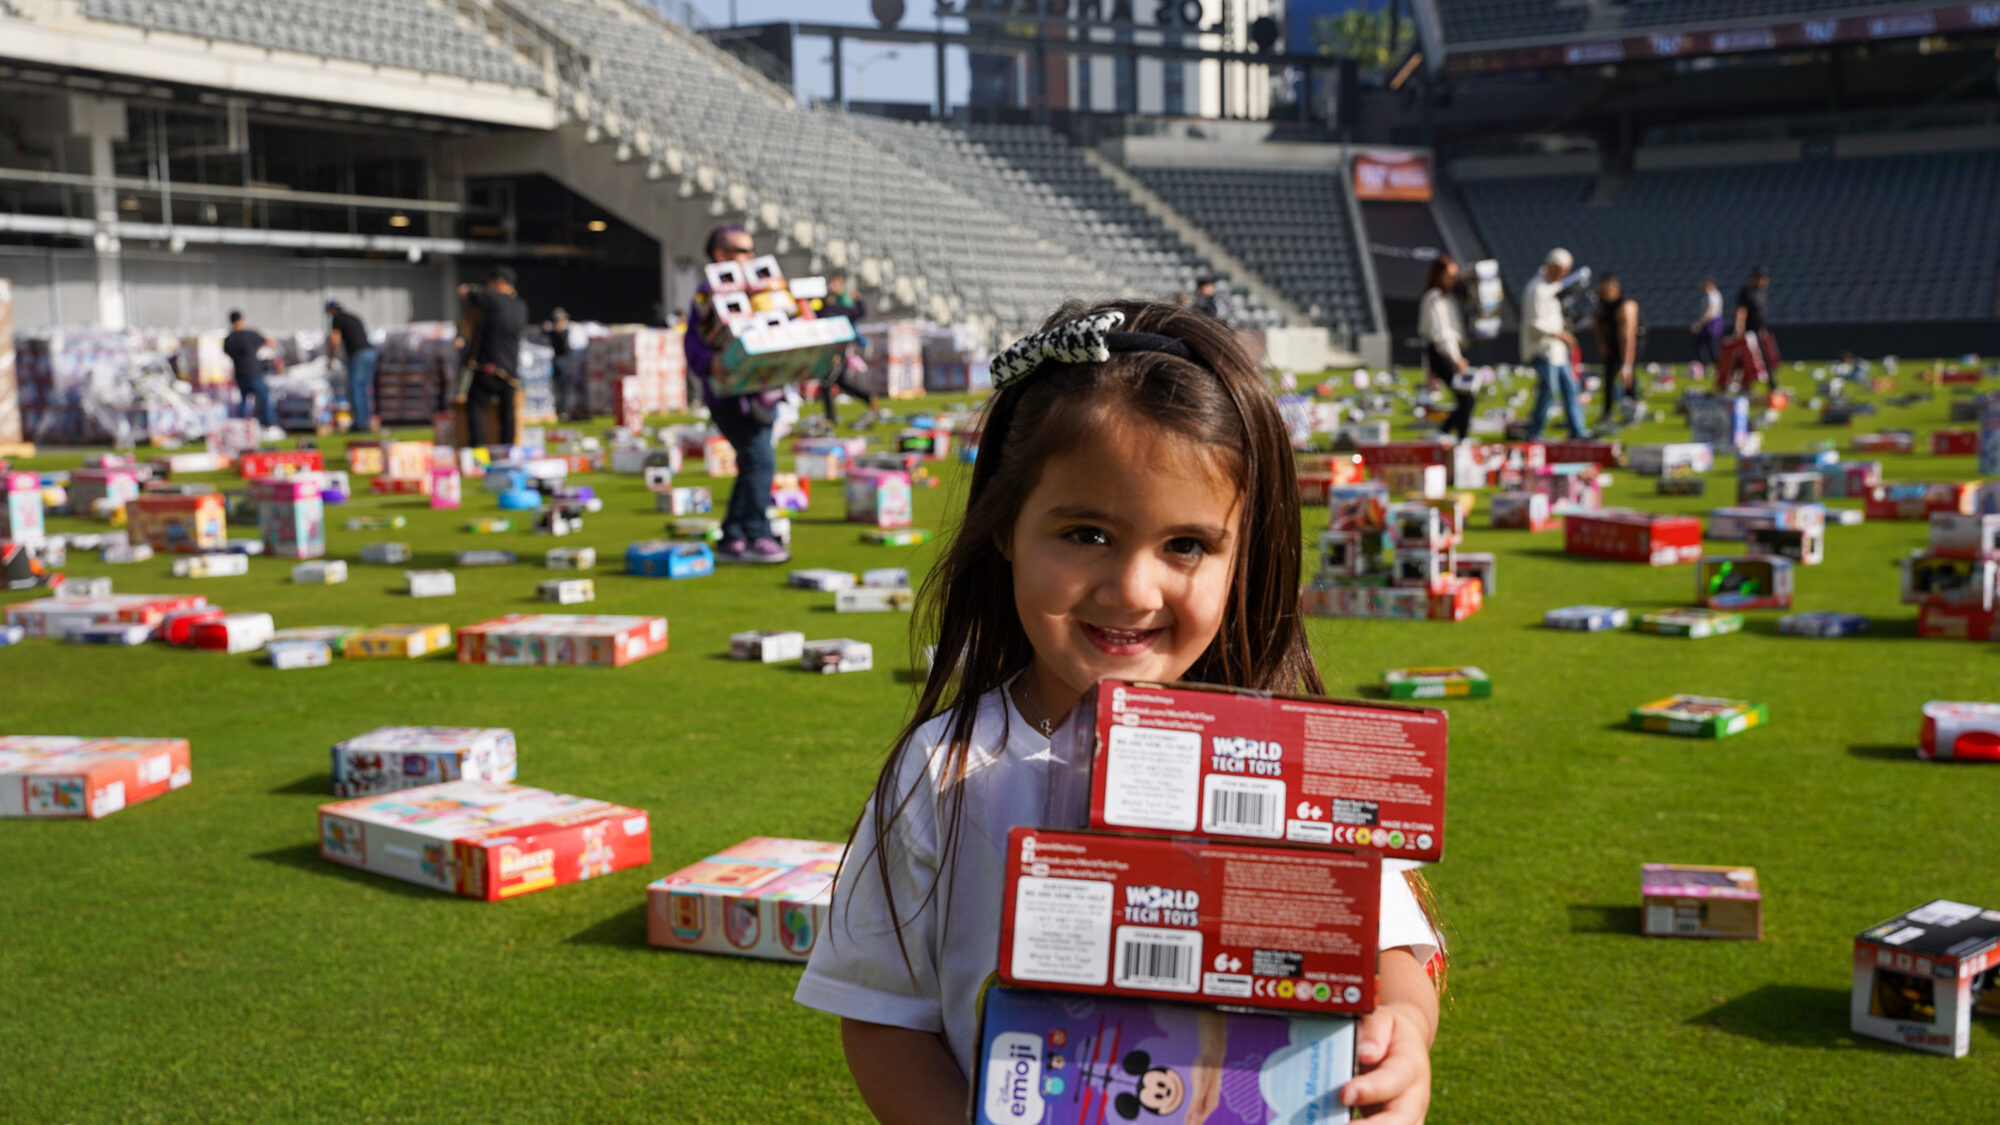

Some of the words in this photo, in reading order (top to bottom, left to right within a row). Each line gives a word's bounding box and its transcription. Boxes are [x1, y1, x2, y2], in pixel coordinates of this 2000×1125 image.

[1212, 736, 1282, 761] WORLD
[1211, 756, 1244, 772] TECH
[1249, 760, 1282, 776] TOYS
[1297, 801, 1323, 820] 6+
[1126, 885, 1200, 910] WORLD
[1124, 906, 1159, 923] TECH
[1163, 910, 1199, 927] TOYS
[1214, 952, 1242, 972] 6+
[1304, 1041, 1319, 1096] Mouse
[1009, 1044, 1036, 1117] emoji
